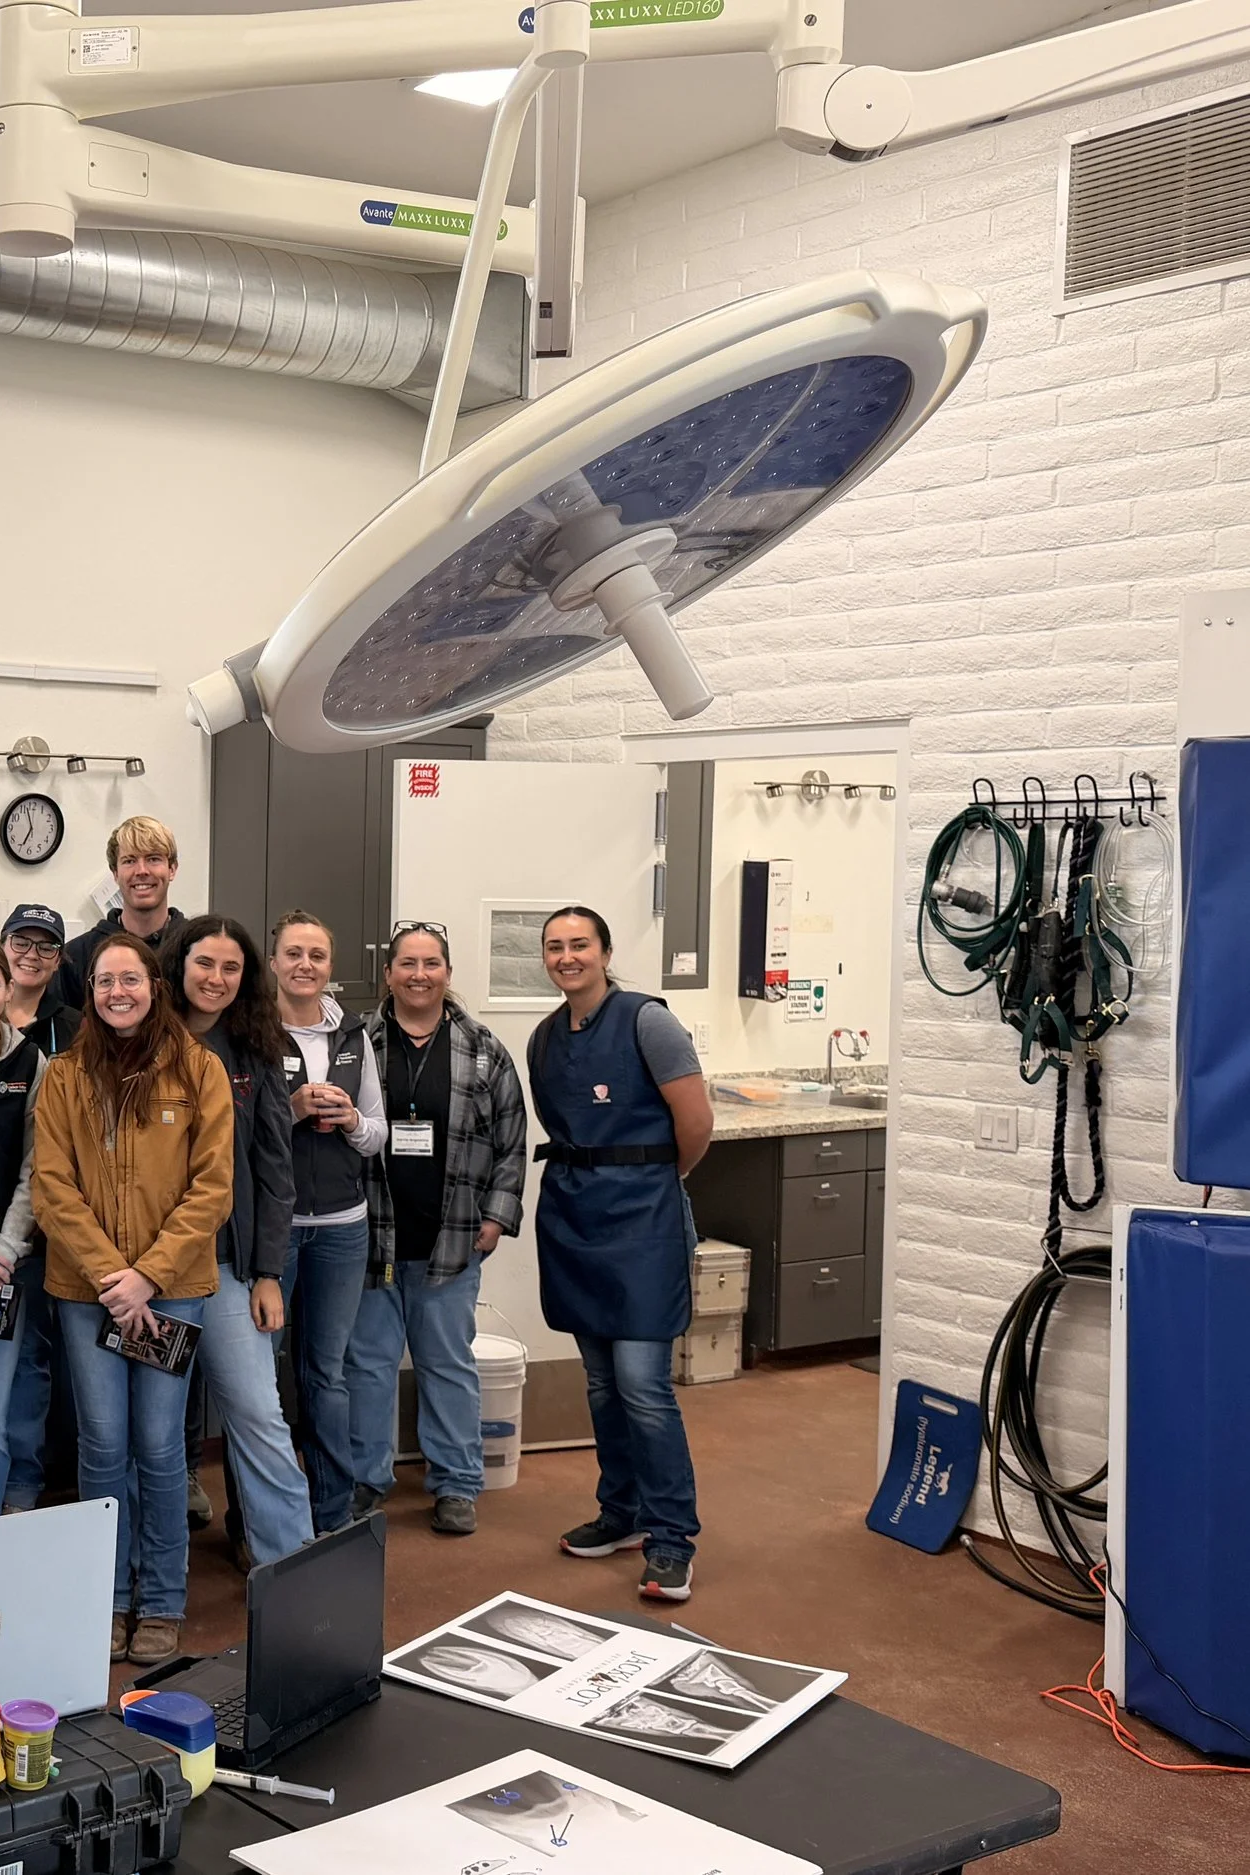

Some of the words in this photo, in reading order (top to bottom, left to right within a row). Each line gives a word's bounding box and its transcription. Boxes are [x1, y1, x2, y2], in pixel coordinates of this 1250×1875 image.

[619, 4, 662, 19] LUXX
[666, 0, 721, 17] LED160
[362, 205, 394, 219] Avante
[398, 211, 432, 225] MAXX
[435, 217, 465, 229] LUXX
[415, 769, 433, 778] FIRE
[19, 804, 26, 814] 11
[29, 801, 37, 811] 12
[40, 804, 44, 815] 1
[11, 812, 20, 823] 10
[46, 813, 52, 823] 2
[7, 823, 14, 833] 9
[48, 824, 54, 834] 3
[10, 834, 16, 845] 8
[43, 835, 49, 844] 4
[17, 843, 23, 854] 7
[26, 846, 32, 856] 6
[36, 843, 42, 854] 5
[910, 1415, 929, 1482] (hyaluronate
[915, 1445, 942, 1505] Legend
[889, 1483, 915, 1525] sodium)
